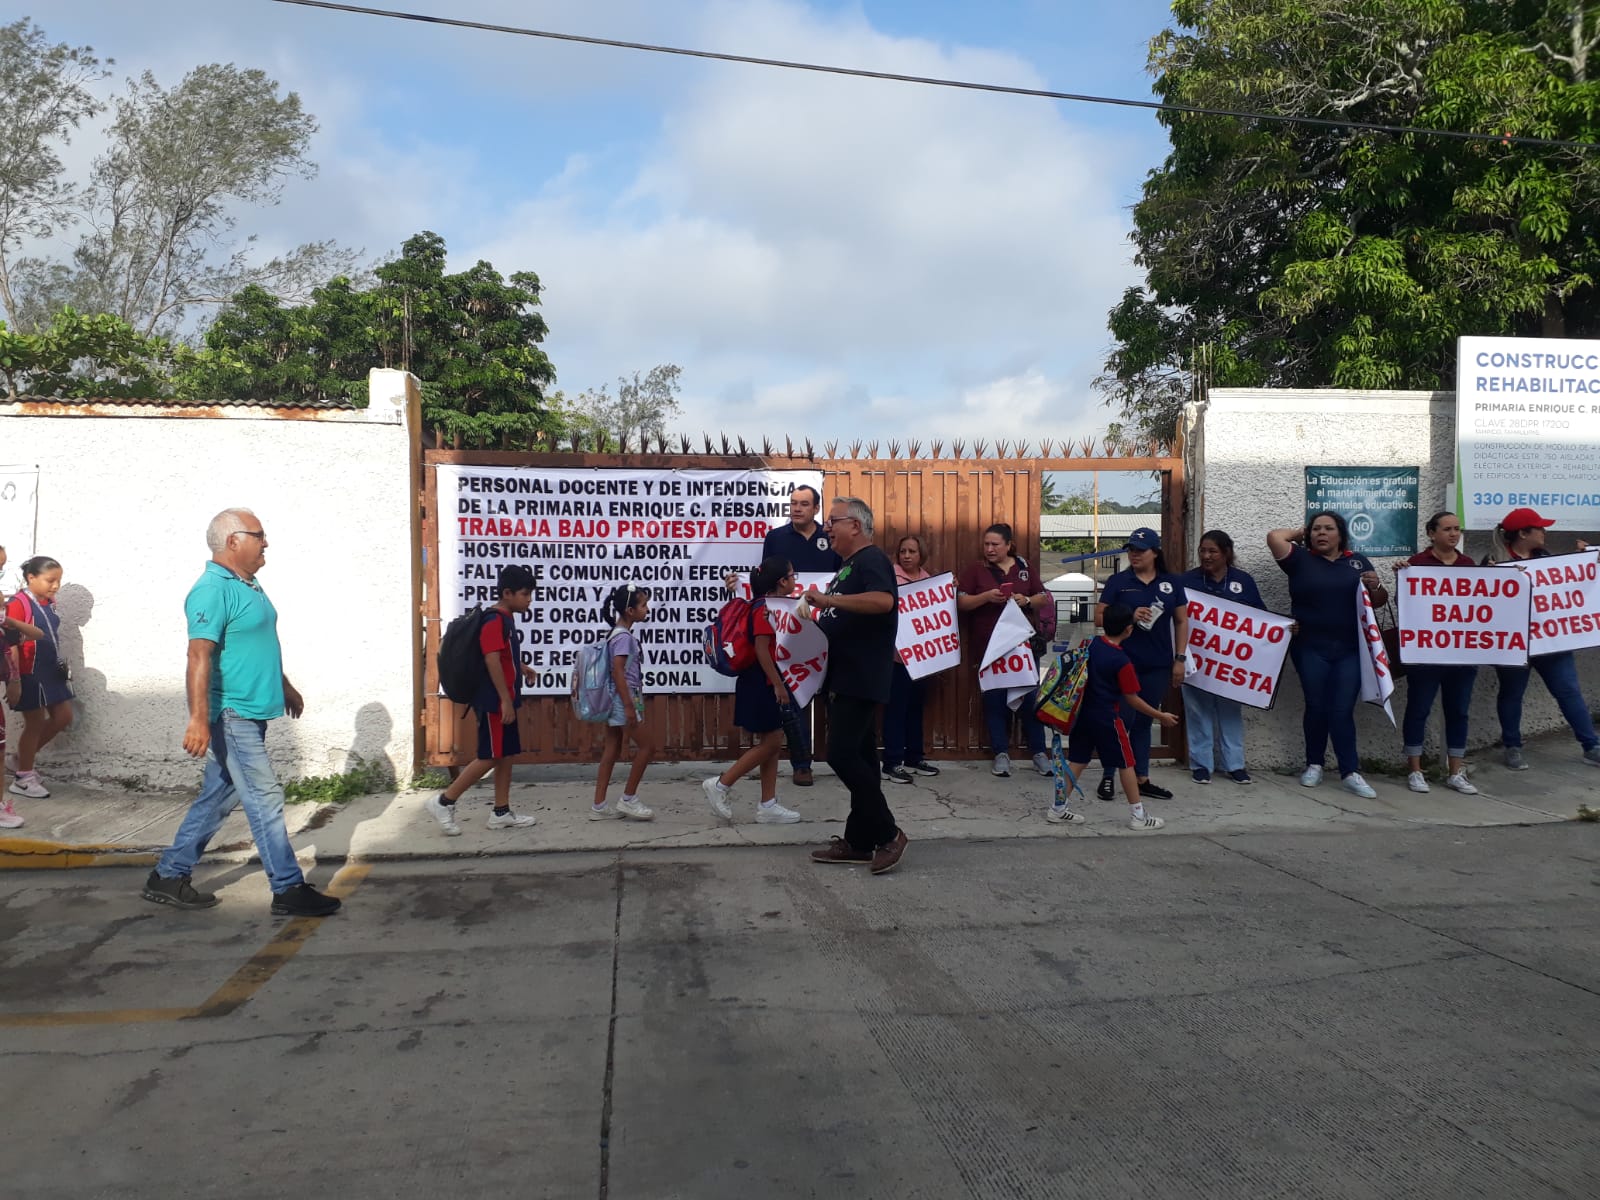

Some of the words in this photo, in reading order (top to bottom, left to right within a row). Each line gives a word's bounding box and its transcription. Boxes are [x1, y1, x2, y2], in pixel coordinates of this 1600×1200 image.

[1476, 352, 1599, 370] CONSTRUCC
[1476, 376, 1600, 394] REHABILITAC
[1475, 403, 1526, 412] PRIMARIA
[1529, 404, 1575, 414] ENRIQUE
[1592, 405, 1600, 414] RE
[458, 476, 553, 494] PERSONAL
[559, 480, 638, 496] DOCENTE
[643, 480, 655, 496] Y
[660, 481, 681, 496] DE
[1306, 476, 1318, 485] La
[1316, 488, 1324, 497] el
[1328, 488, 1393, 497] mantenimiento
[1395, 489, 1406, 497] de
[1473, 492, 1504, 506] 330
[1508, 492, 1600, 506] BENEFICIAD
[458, 498, 482, 514] DE
[487, 499, 508, 515] LA
[515, 500, 603, 516] PRIMARIA
[609, 502, 684, 520] ENRIQUE
[690, 502, 706, 517] C.
[712, 498, 790, 518] RÉBSAME
[1308, 500, 1320, 510] los
[1322, 500, 1363, 512] planteles
[458, 518, 551, 537] TRABAJA
[558, 520, 610, 538] BAJO
[618, 520, 718, 538] PROTESTA
[1353, 522, 1370, 532] NO
[458, 542, 608, 560] -HOSTIGAMIENTO
[614, 544, 692, 560] LABORAL
[458, 564, 502, 580] -FALT
[550, 562, 683, 581] COMUNICACIÓN
[458, 586, 587, 602] -PREENCIA
[592, 587, 603, 602] Y
[1406, 578, 1520, 598] TRABAJO
[898, 583, 956, 614] RABAJO
[1534, 589, 1585, 614] BAJO
[521, 608, 544, 623] DE
[686, 608, 719, 623] ESC
[911, 610, 953, 637] BAJO
[1186, 600, 1284, 644] RABAJO
[1432, 604, 1493, 624] BAJO
[1529, 612, 1600, 641] ROTEST
[530, 630, 554, 644] DE
[559, 630, 606, 645] PODE
[640, 629, 704, 644] MENTIR
[1190, 627, 1253, 662] BAJO
[1400, 630, 1526, 651] PROTESTA
[521, 650, 544, 666] DE
[648, 650, 709, 665] VALOR
[901, 631, 960, 666] PROTES
[1192, 652, 1273, 695] OTESTA
